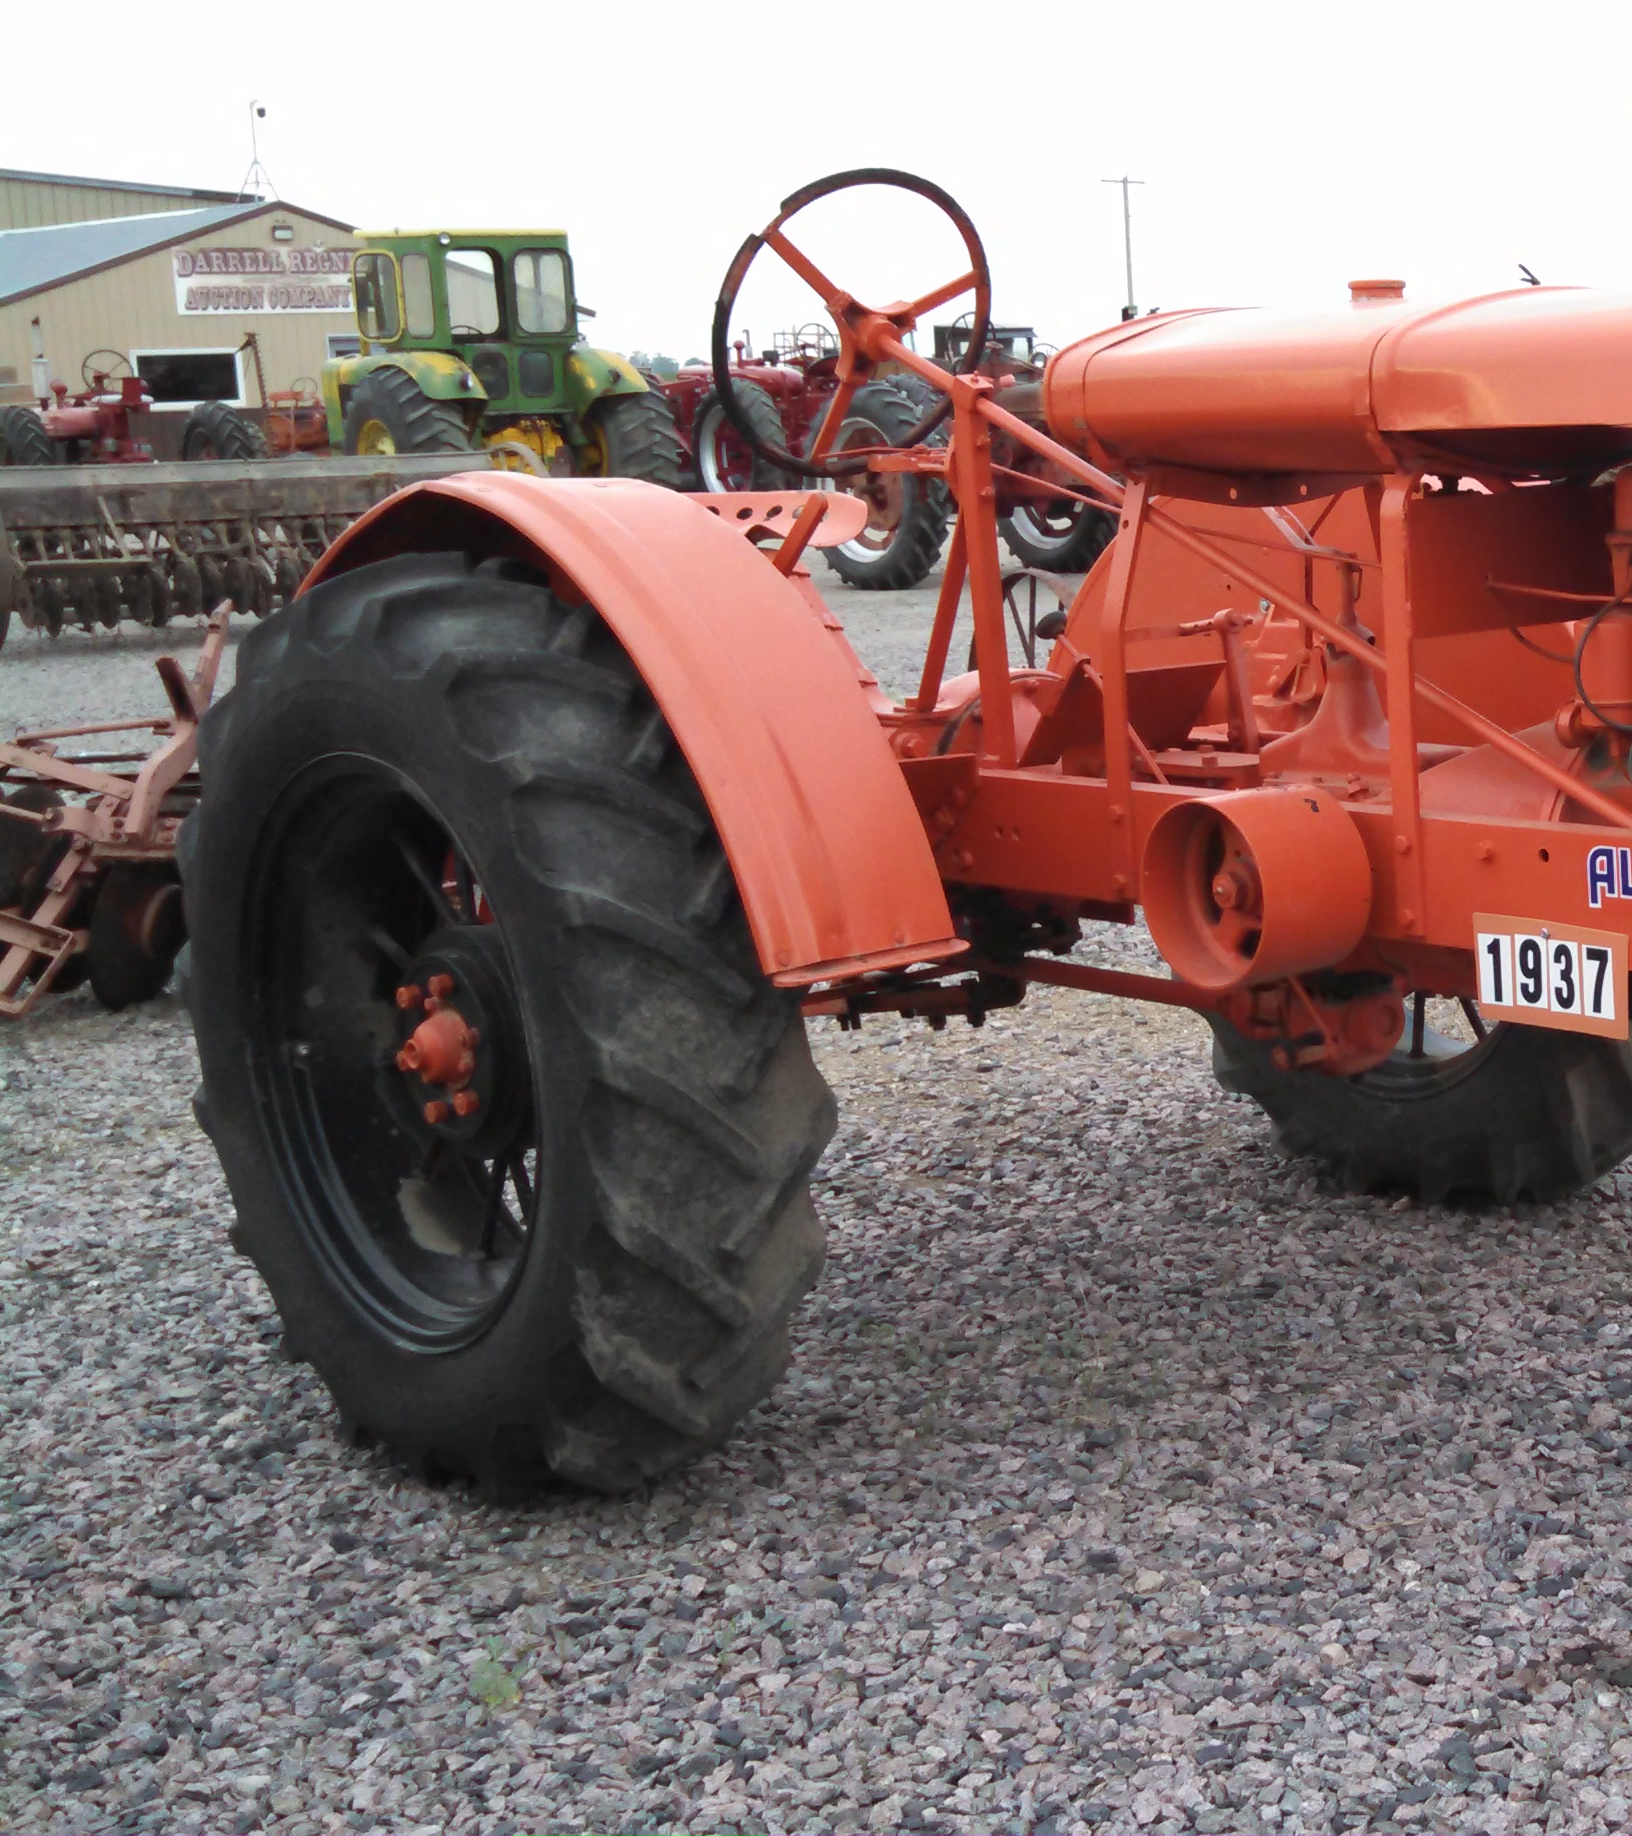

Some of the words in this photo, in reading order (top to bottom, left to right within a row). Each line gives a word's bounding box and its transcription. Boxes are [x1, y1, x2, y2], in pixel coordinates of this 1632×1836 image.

[177, 249, 286, 277] DARRELL
[185, 286, 265, 311] AUCTION
[268, 286, 351, 310] COMPANY
[1485, 936, 1613, 1015] 1937
